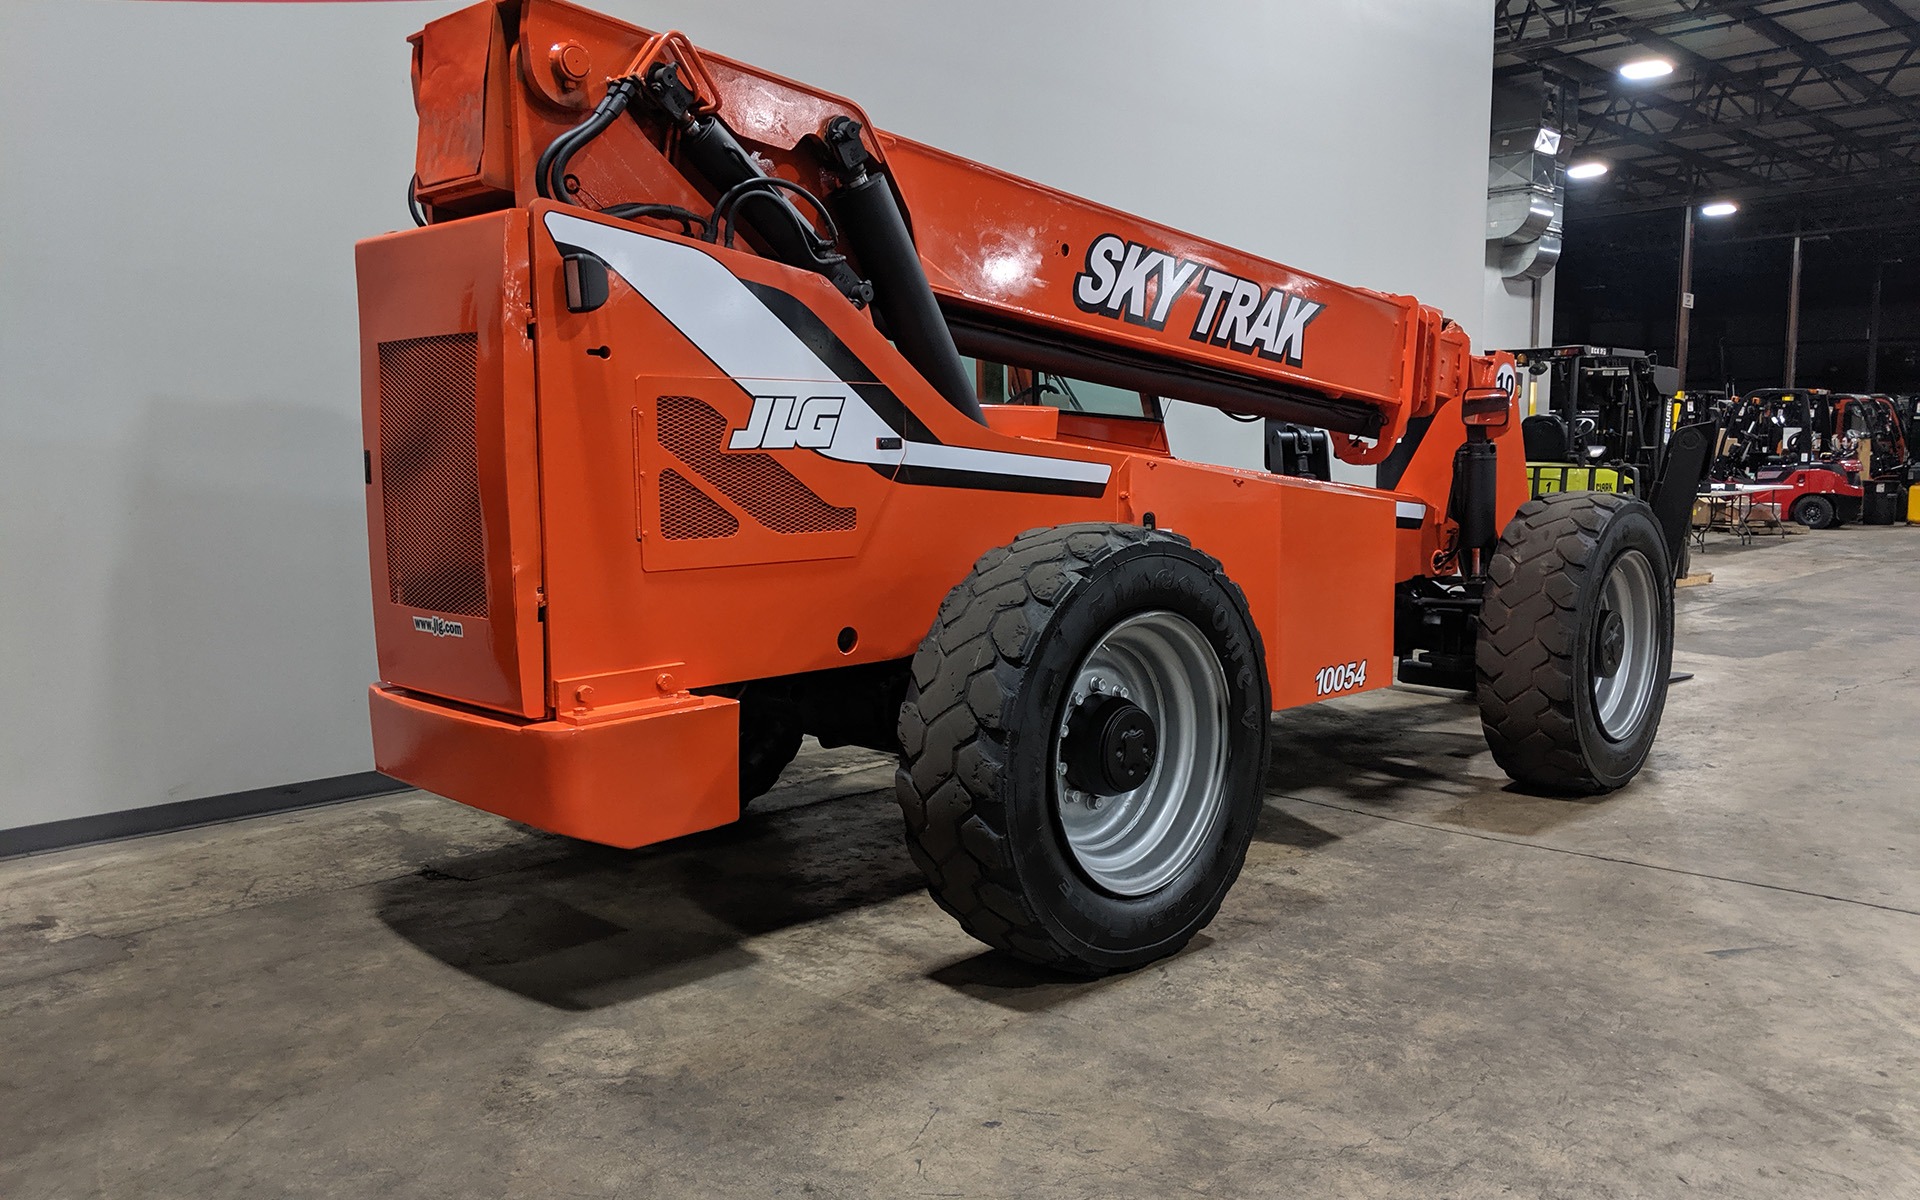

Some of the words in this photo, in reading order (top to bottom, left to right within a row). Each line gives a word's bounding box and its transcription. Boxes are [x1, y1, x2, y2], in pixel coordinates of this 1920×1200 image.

[1074, 233, 1203, 330] SKY
[1190, 267, 1324, 367] TRAK
[1496, 372, 1514, 396] 10
[728, 395, 846, 450] JLG
[1665, 398, 1673, 428] CLARK
[1545, 481, 1552, 493] 1
[1596, 483, 1613, 492] CLARK
[414, 617, 463, 636] www.jlg.com
[1315, 659, 1367, 696] 10054
